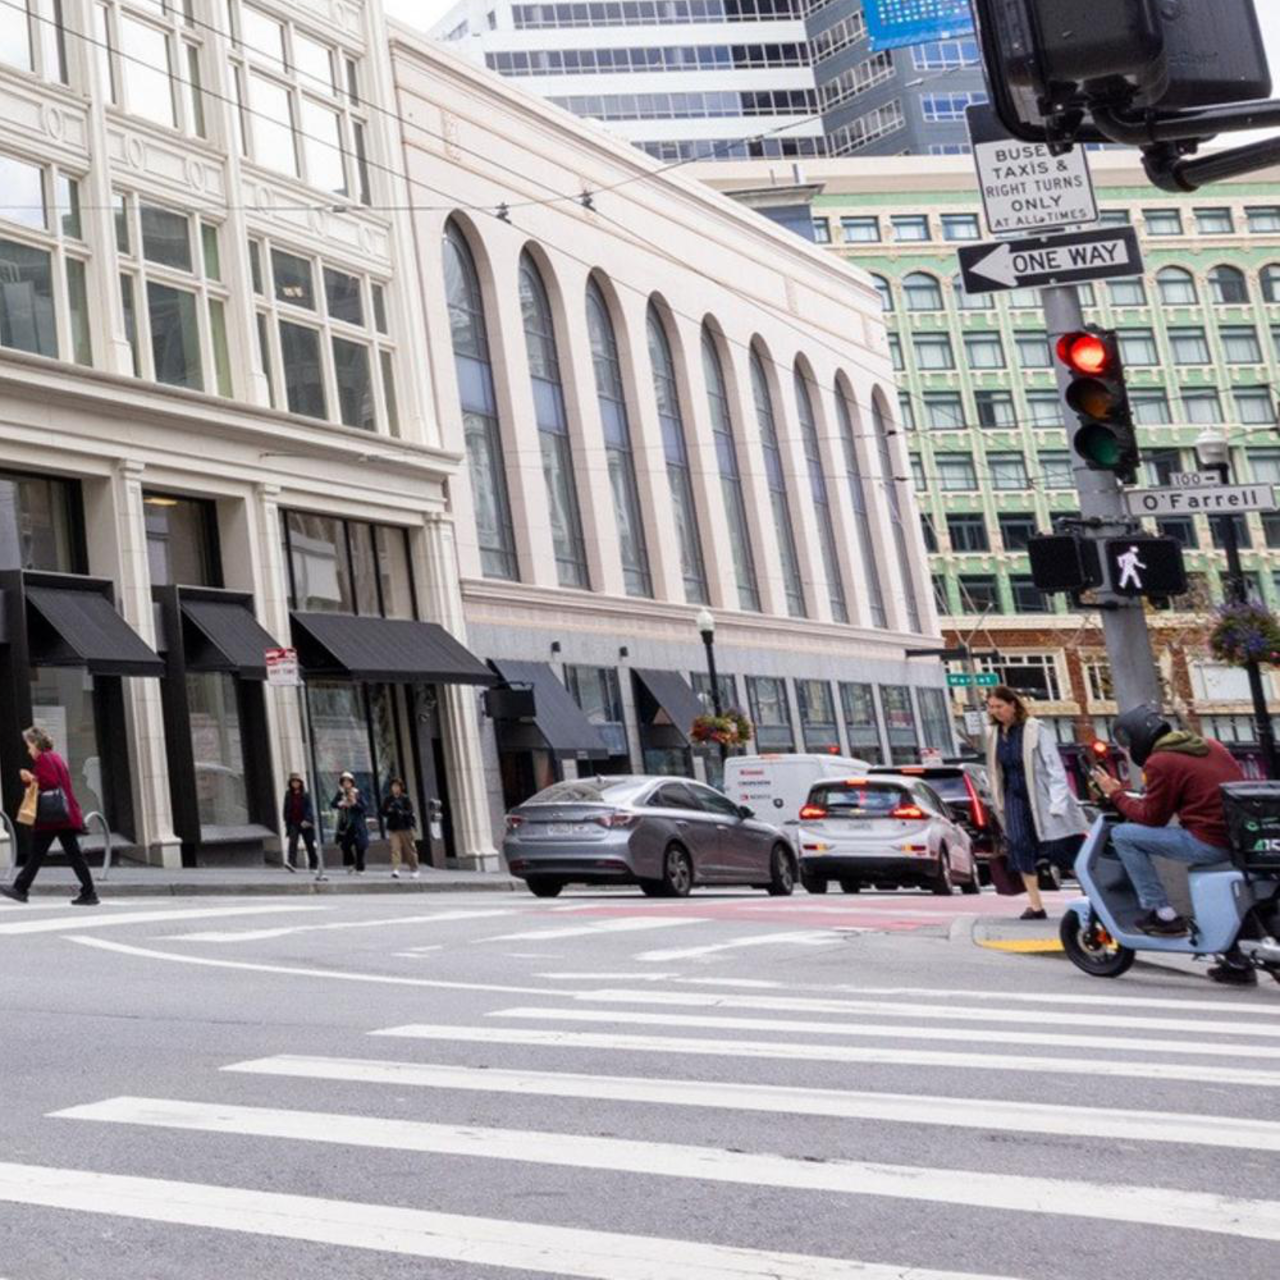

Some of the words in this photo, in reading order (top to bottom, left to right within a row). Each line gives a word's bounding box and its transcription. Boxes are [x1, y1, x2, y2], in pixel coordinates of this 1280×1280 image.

[995, 144, 1047, 162] BUSE
[992, 162, 1049, 180] TAXIS
[1056, 160, 1068, 172] &
[986, 182, 1027, 198] RIGHT
[1034, 175, 1083, 193] TURNS
[1011, 195, 1062, 212] ONLY
[994, 218, 1009, 228] AT
[1016, 214, 1040, 225] ALL
[1047, 208, 1088, 222] TIMES
[1012, 250, 1061, 274] ONE
[1068, 243, 1118, 267] WAY
[1175, 473, 1201, 486] 100
[1142, 490, 1257, 511] O'Farrell
[949, 675, 991, 685] Maret
